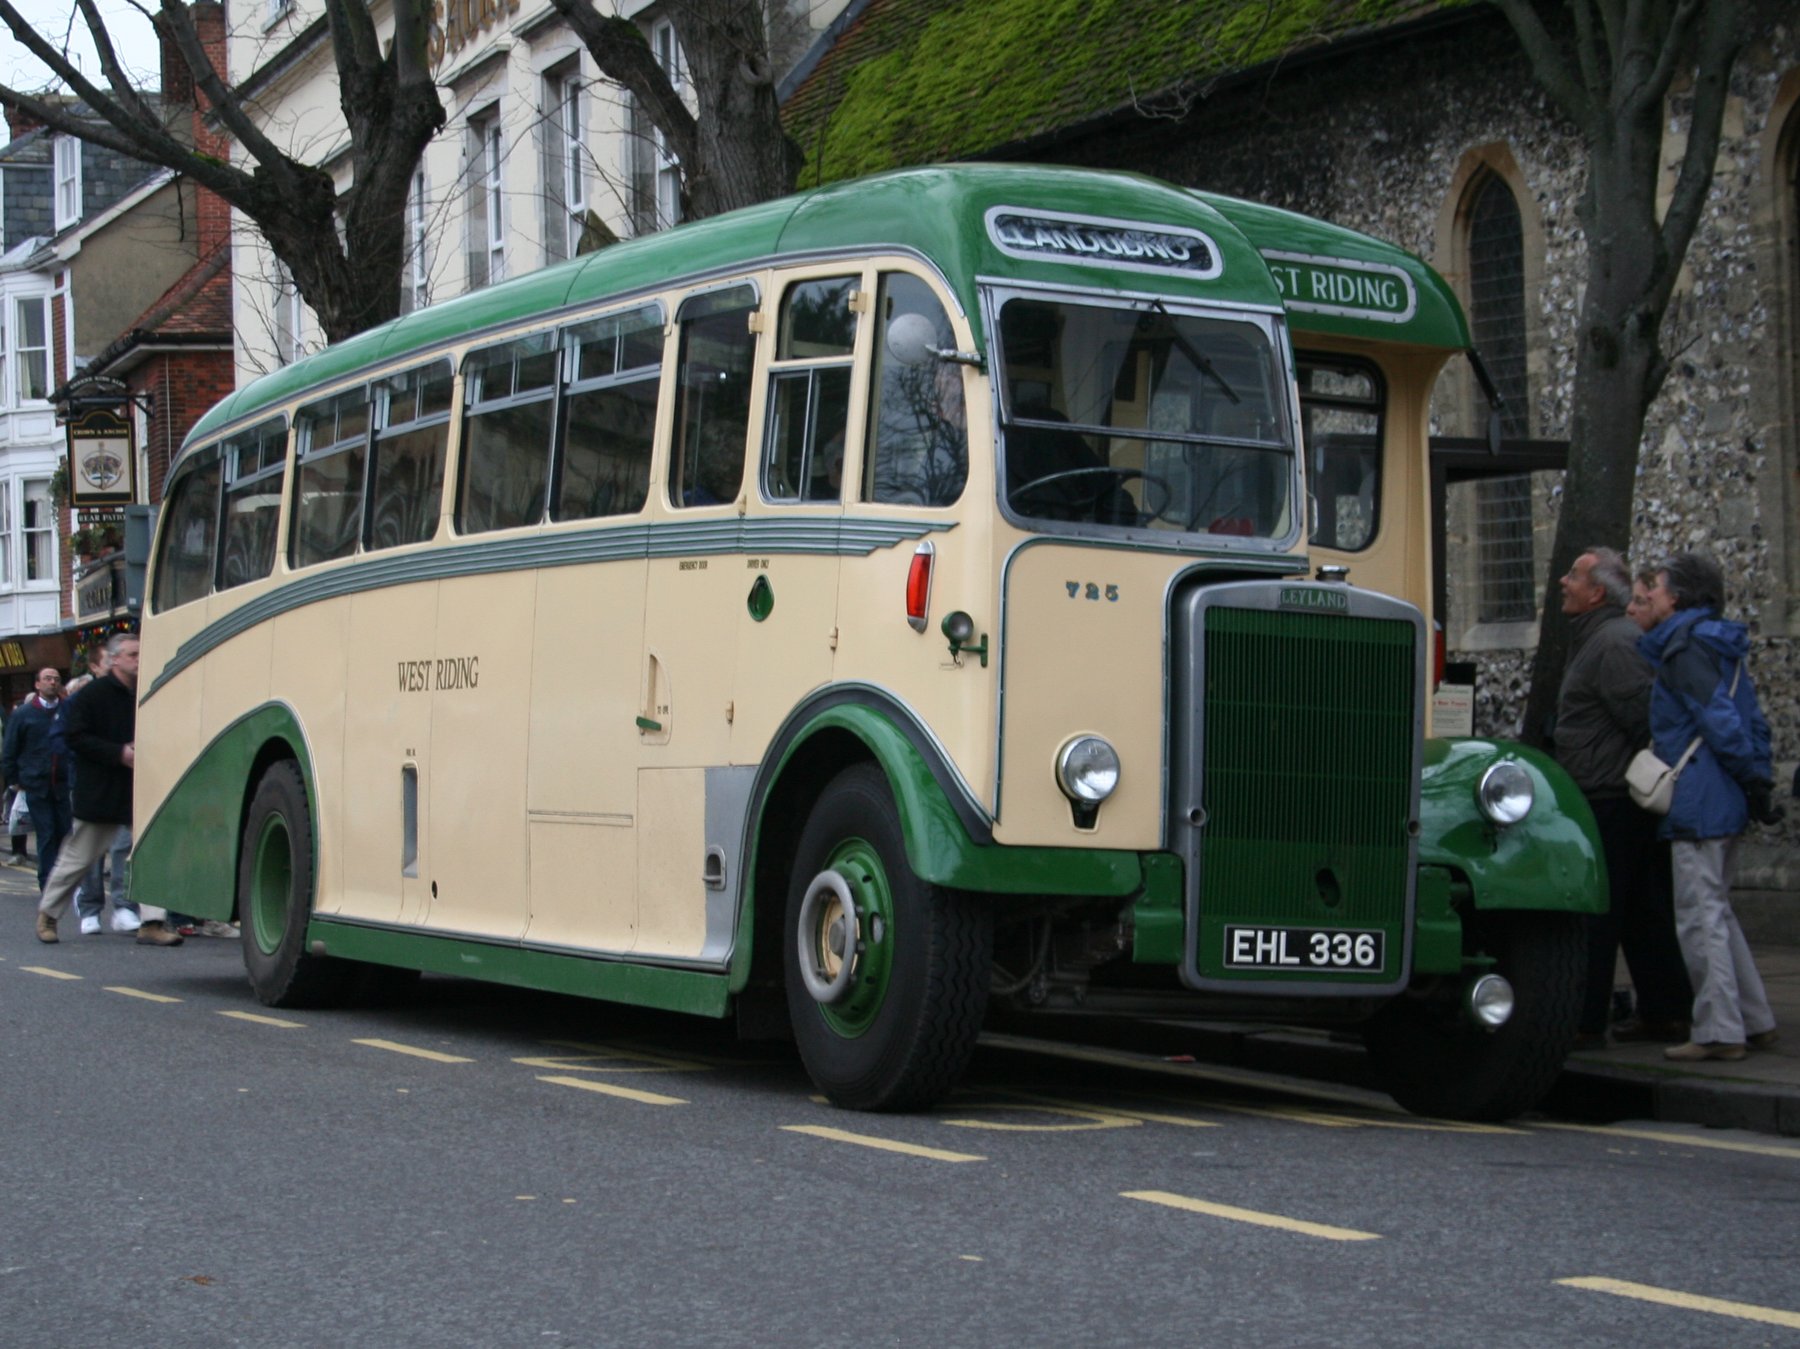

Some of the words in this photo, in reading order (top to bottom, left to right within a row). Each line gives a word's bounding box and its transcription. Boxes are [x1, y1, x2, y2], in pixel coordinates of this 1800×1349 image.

[1271, 266, 1301, 296] ST
[1310, 270, 1398, 308] RIDING
[78, 513, 101, 521] REAR
[1065, 580, 1119, 602] 725
[1281, 589, 1347, 609] LEYLAND
[398, 660, 432, 693] WEST
[435, 656, 479, 690] RIDING
[1233, 929, 1300, 964] EHL
[1309, 932, 1376, 966] 336
